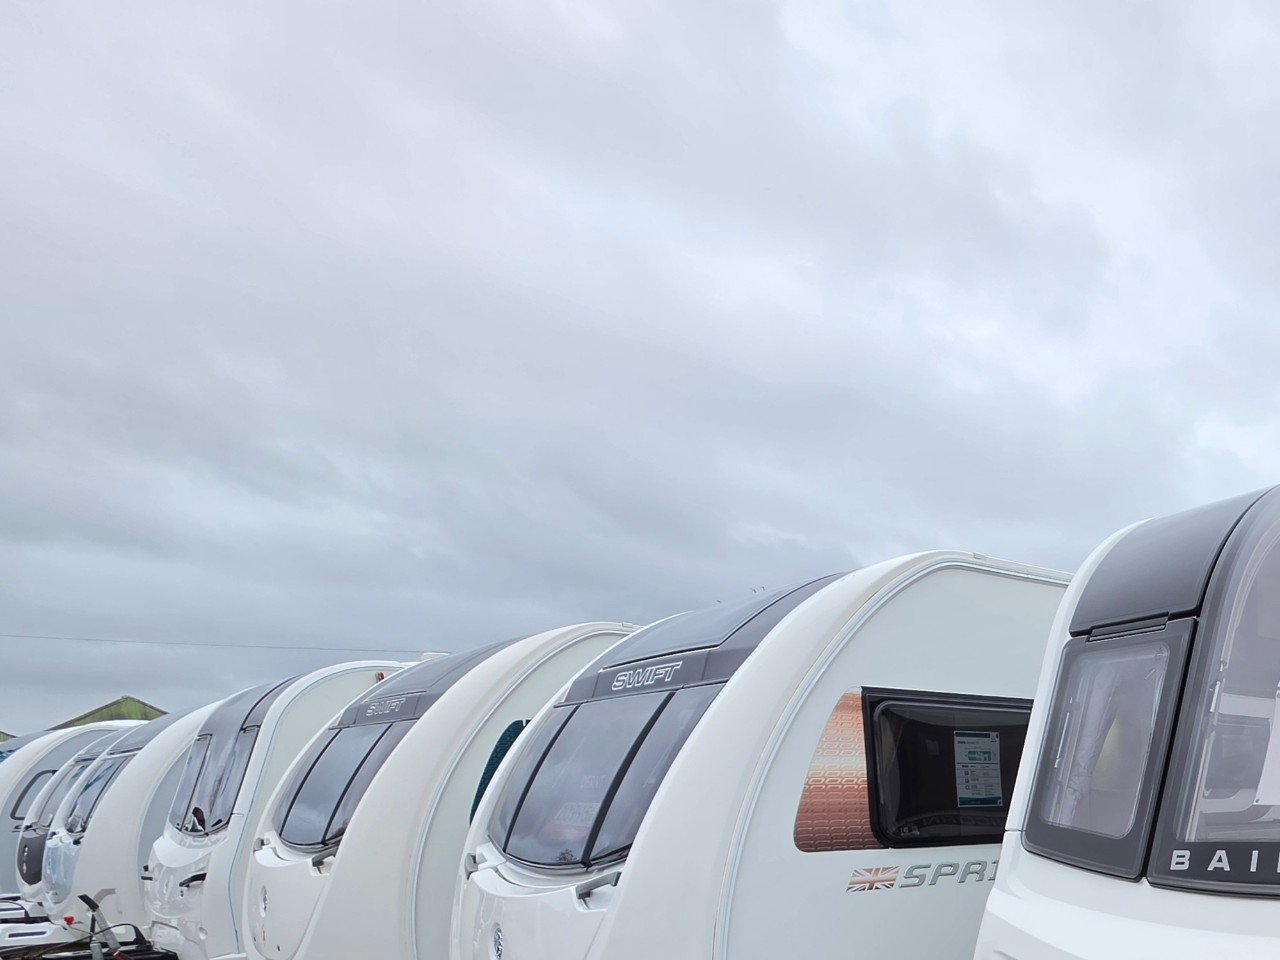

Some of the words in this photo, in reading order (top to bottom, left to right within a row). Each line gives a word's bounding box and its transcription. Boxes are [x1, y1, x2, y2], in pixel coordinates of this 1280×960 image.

[611, 661, 683, 691] SWIFT
[366, 697, 407, 716] SWIFT
[899, 859, 1000, 888] SPRI
